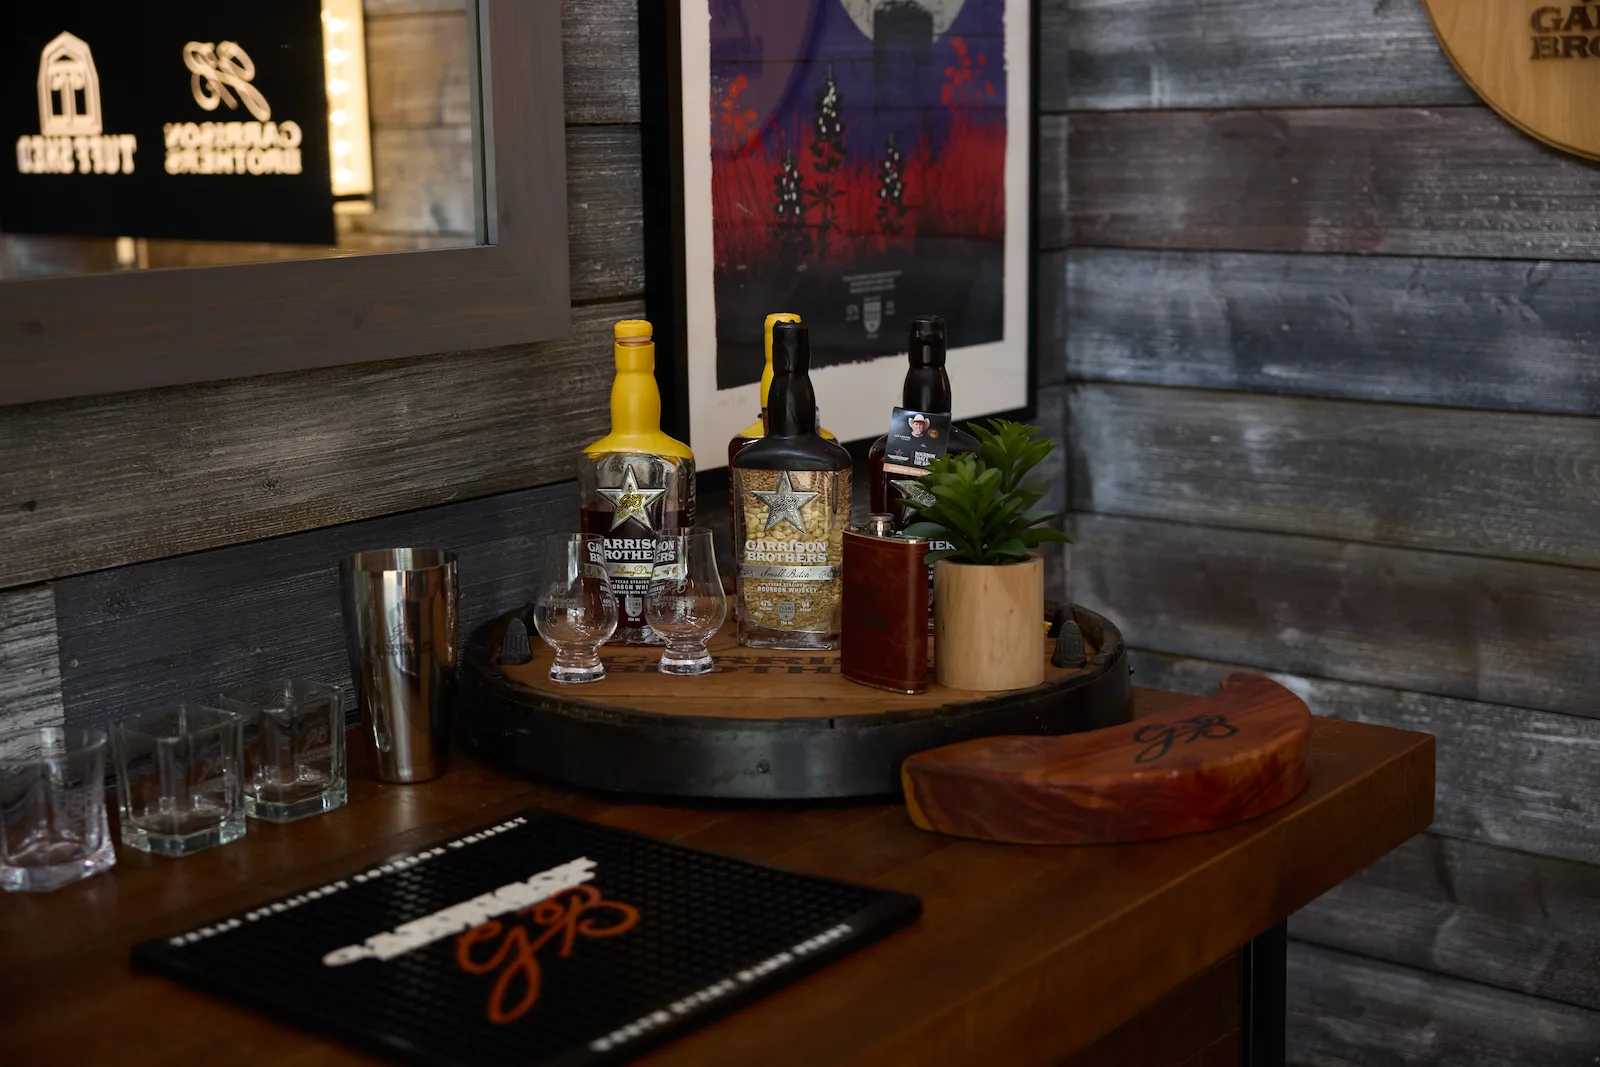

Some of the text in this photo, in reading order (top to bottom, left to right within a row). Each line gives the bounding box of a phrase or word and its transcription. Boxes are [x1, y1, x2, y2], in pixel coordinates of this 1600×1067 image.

[1531, 5, 1600, 33] GA
[745, 541, 828, 553] GARRISON
[746, 551, 828, 563] BROTHERS
